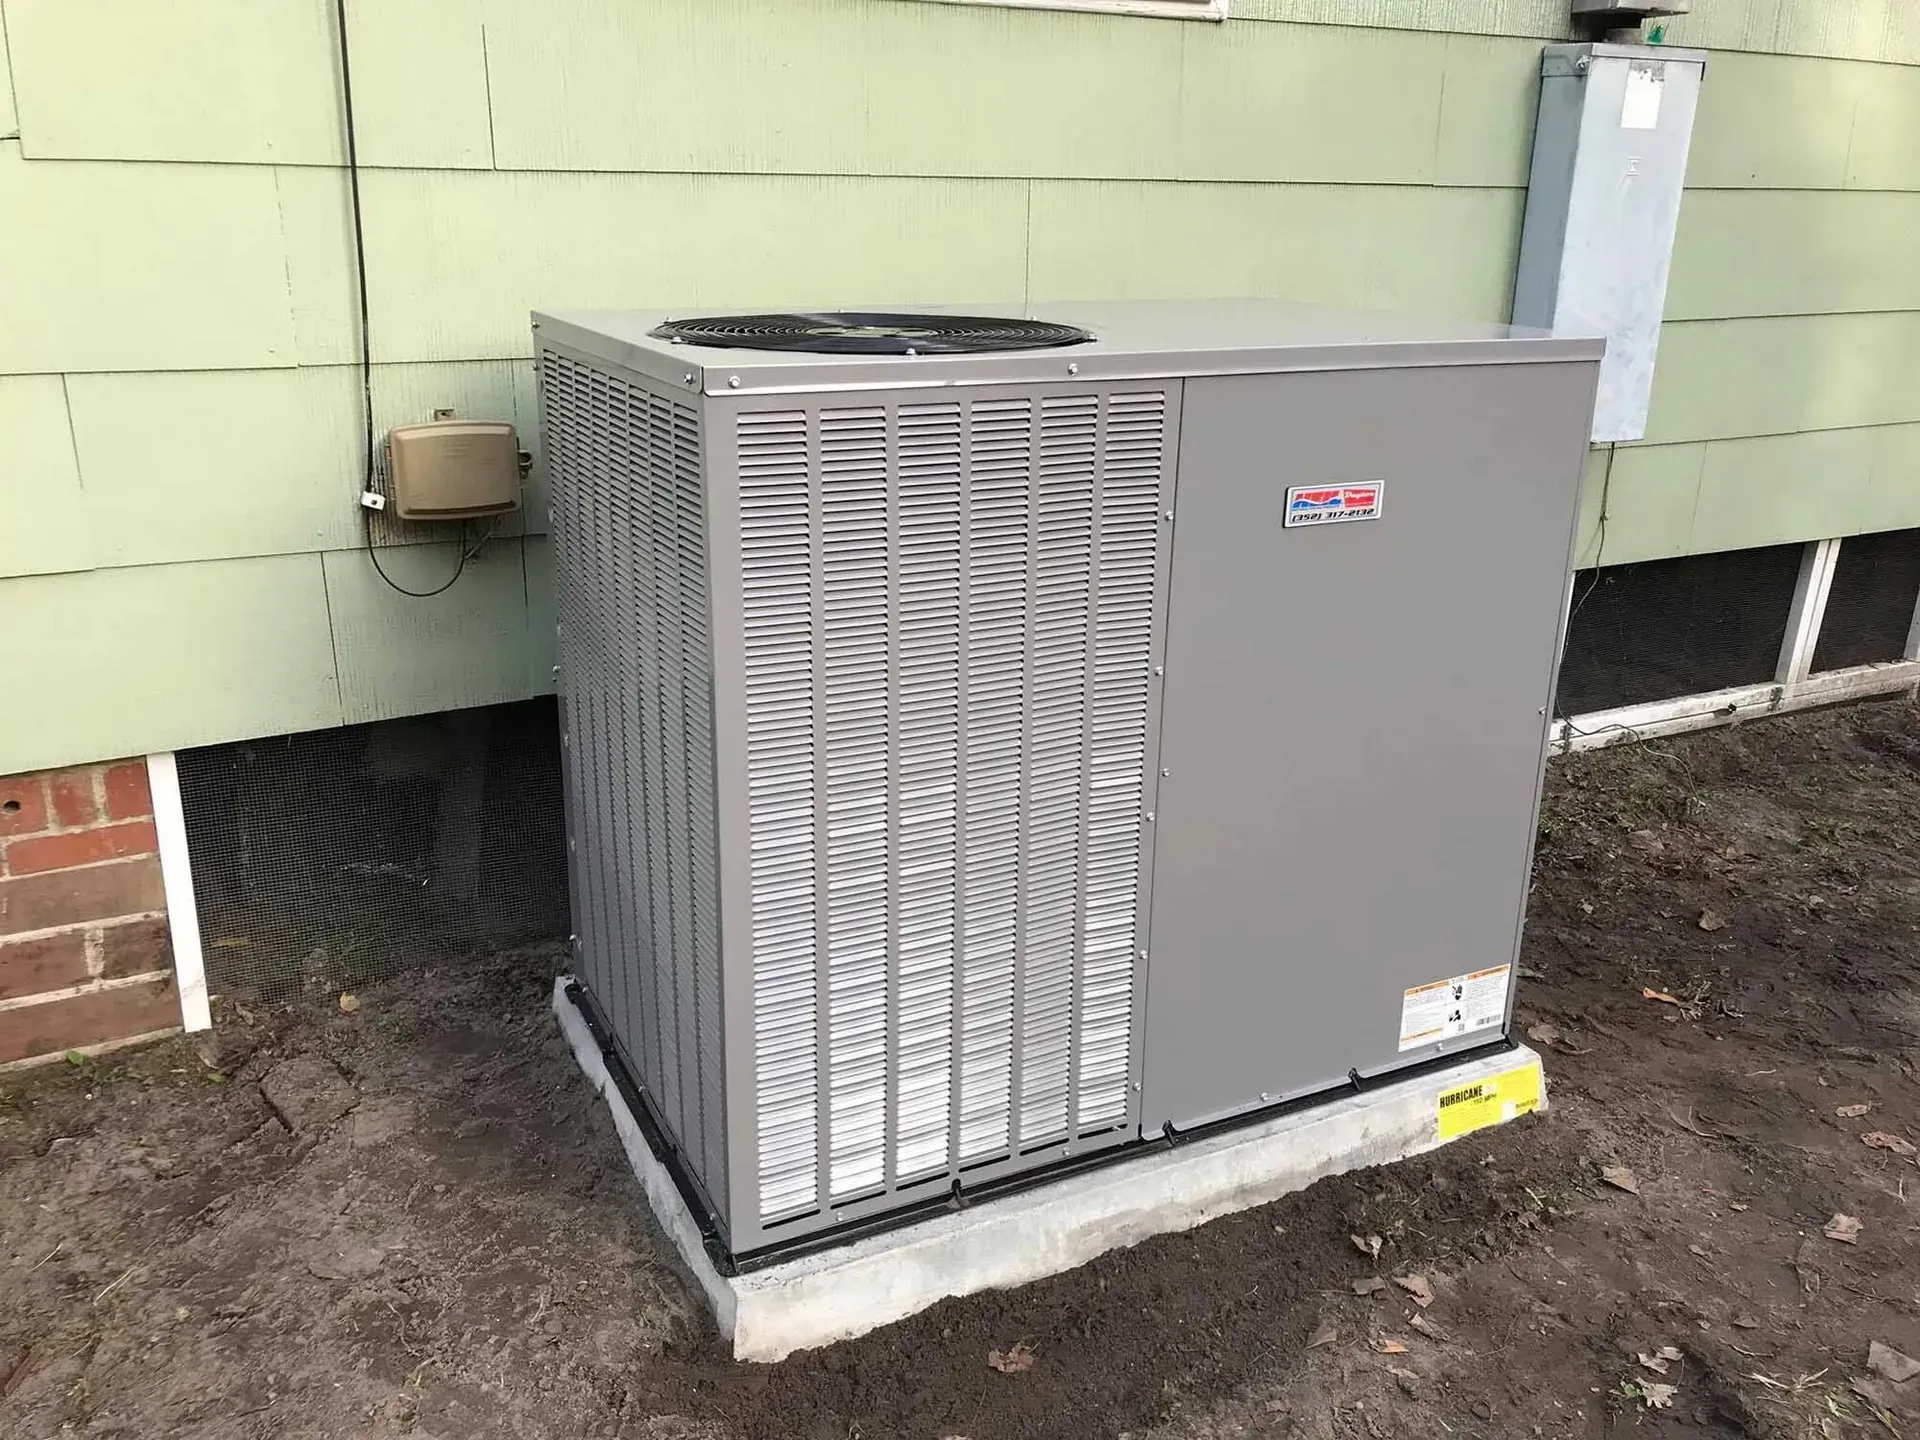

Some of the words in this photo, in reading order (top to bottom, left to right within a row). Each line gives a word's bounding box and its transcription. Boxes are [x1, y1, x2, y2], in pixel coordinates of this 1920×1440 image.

[1292, 513, 1322, 522] (352)
[1326, 508, 1374, 519] 317-2132
[1440, 1085, 1483, 1108] HURRICANE
